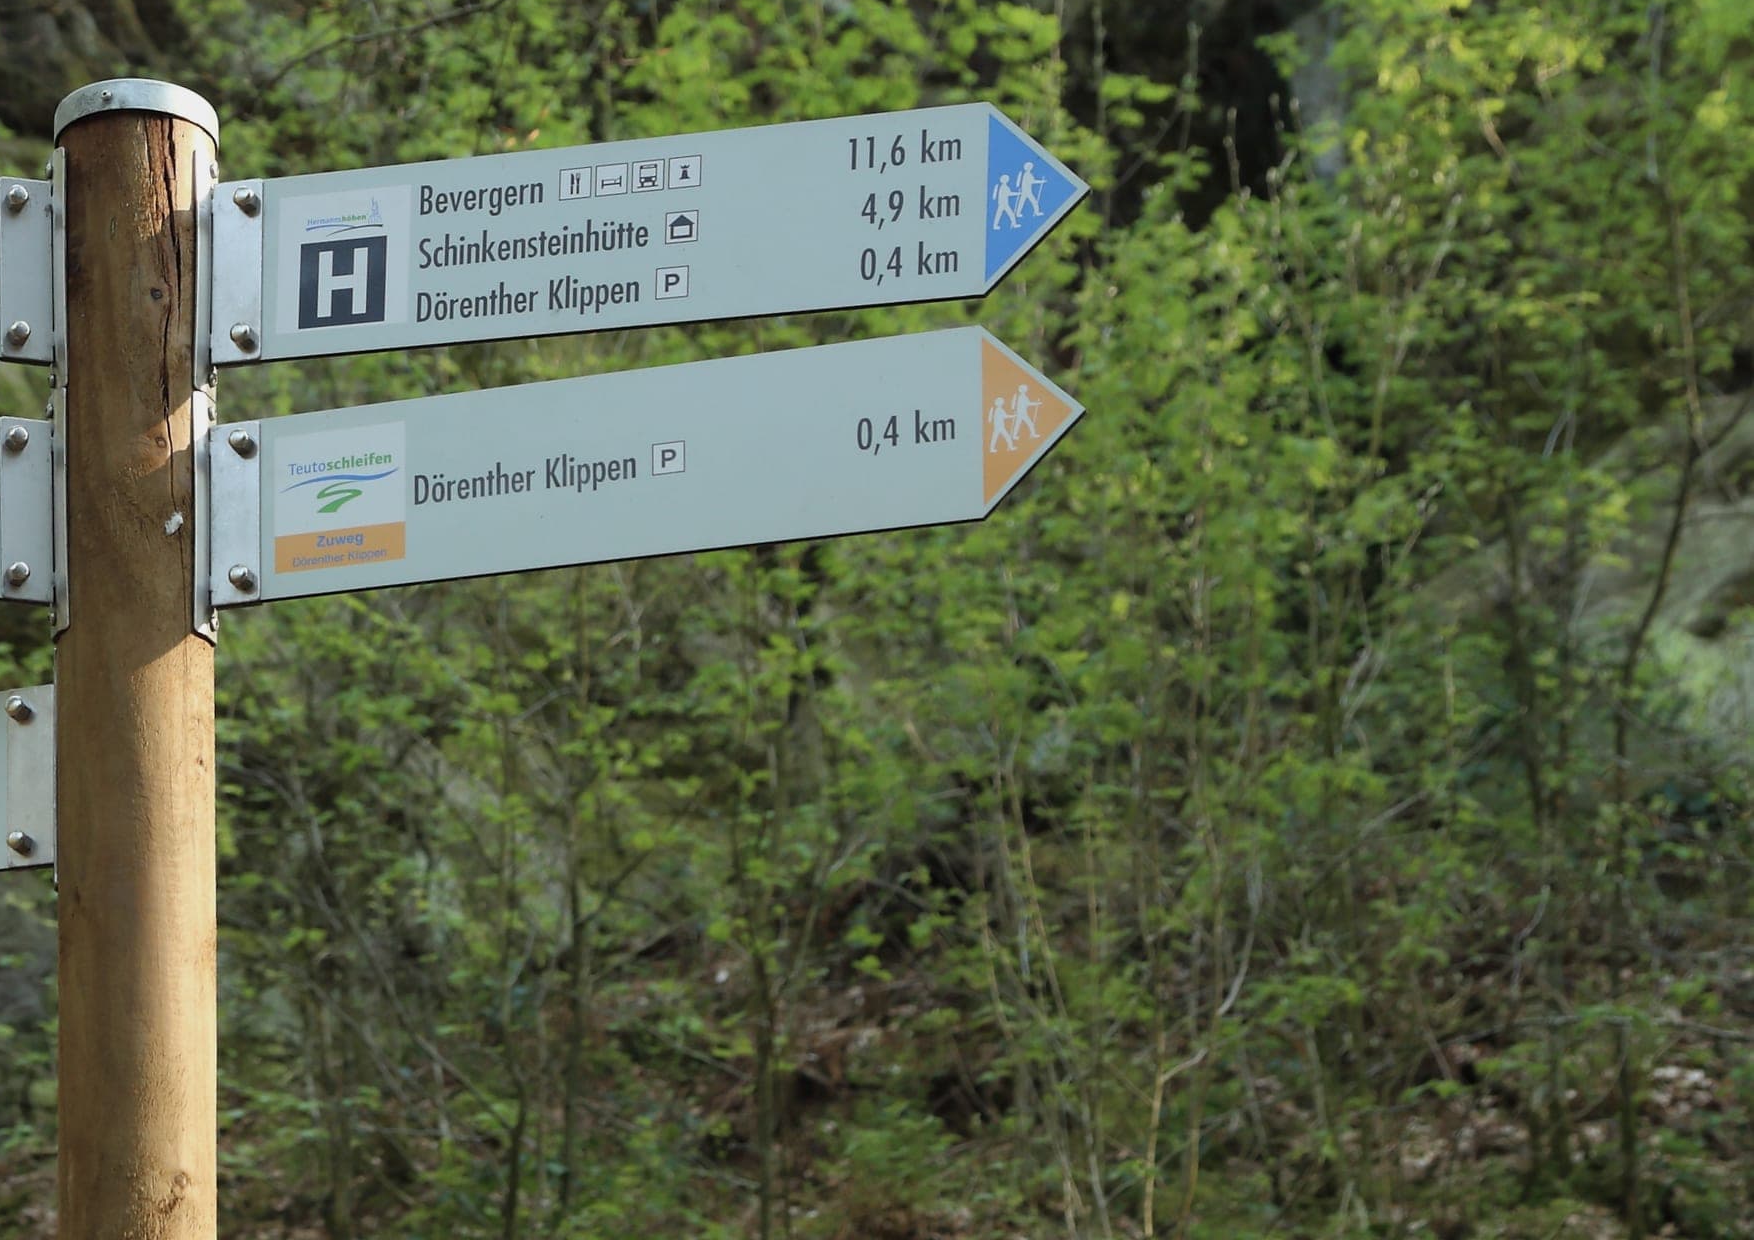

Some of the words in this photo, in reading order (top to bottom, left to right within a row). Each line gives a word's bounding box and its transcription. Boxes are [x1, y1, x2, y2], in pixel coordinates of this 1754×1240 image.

[849, 134, 905, 174] 11,6
[920, 129, 961, 164] km
[306, 213, 367, 227] Hermannshöhen
[419, 179, 544, 216] Bevergern
[861, 190, 904, 230] 4,9
[919, 185, 960, 220] km
[418, 219, 648, 269] Schinkensteinhütte
[860, 246, 903, 286] 0,4
[917, 241, 958, 276] km
[317, 247, 368, 319] H
[416, 282, 539, 322] Dörenther
[549, 274, 639, 315] Klippen
[856, 415, 899, 456] 0,4
[915, 410, 955, 444] km
[288, 451, 392, 476] Teutoschleifen
[414, 462, 536, 505] Dörenther
[545, 453, 637, 493] Klippen
[316, 531, 364, 548] Zuweg
